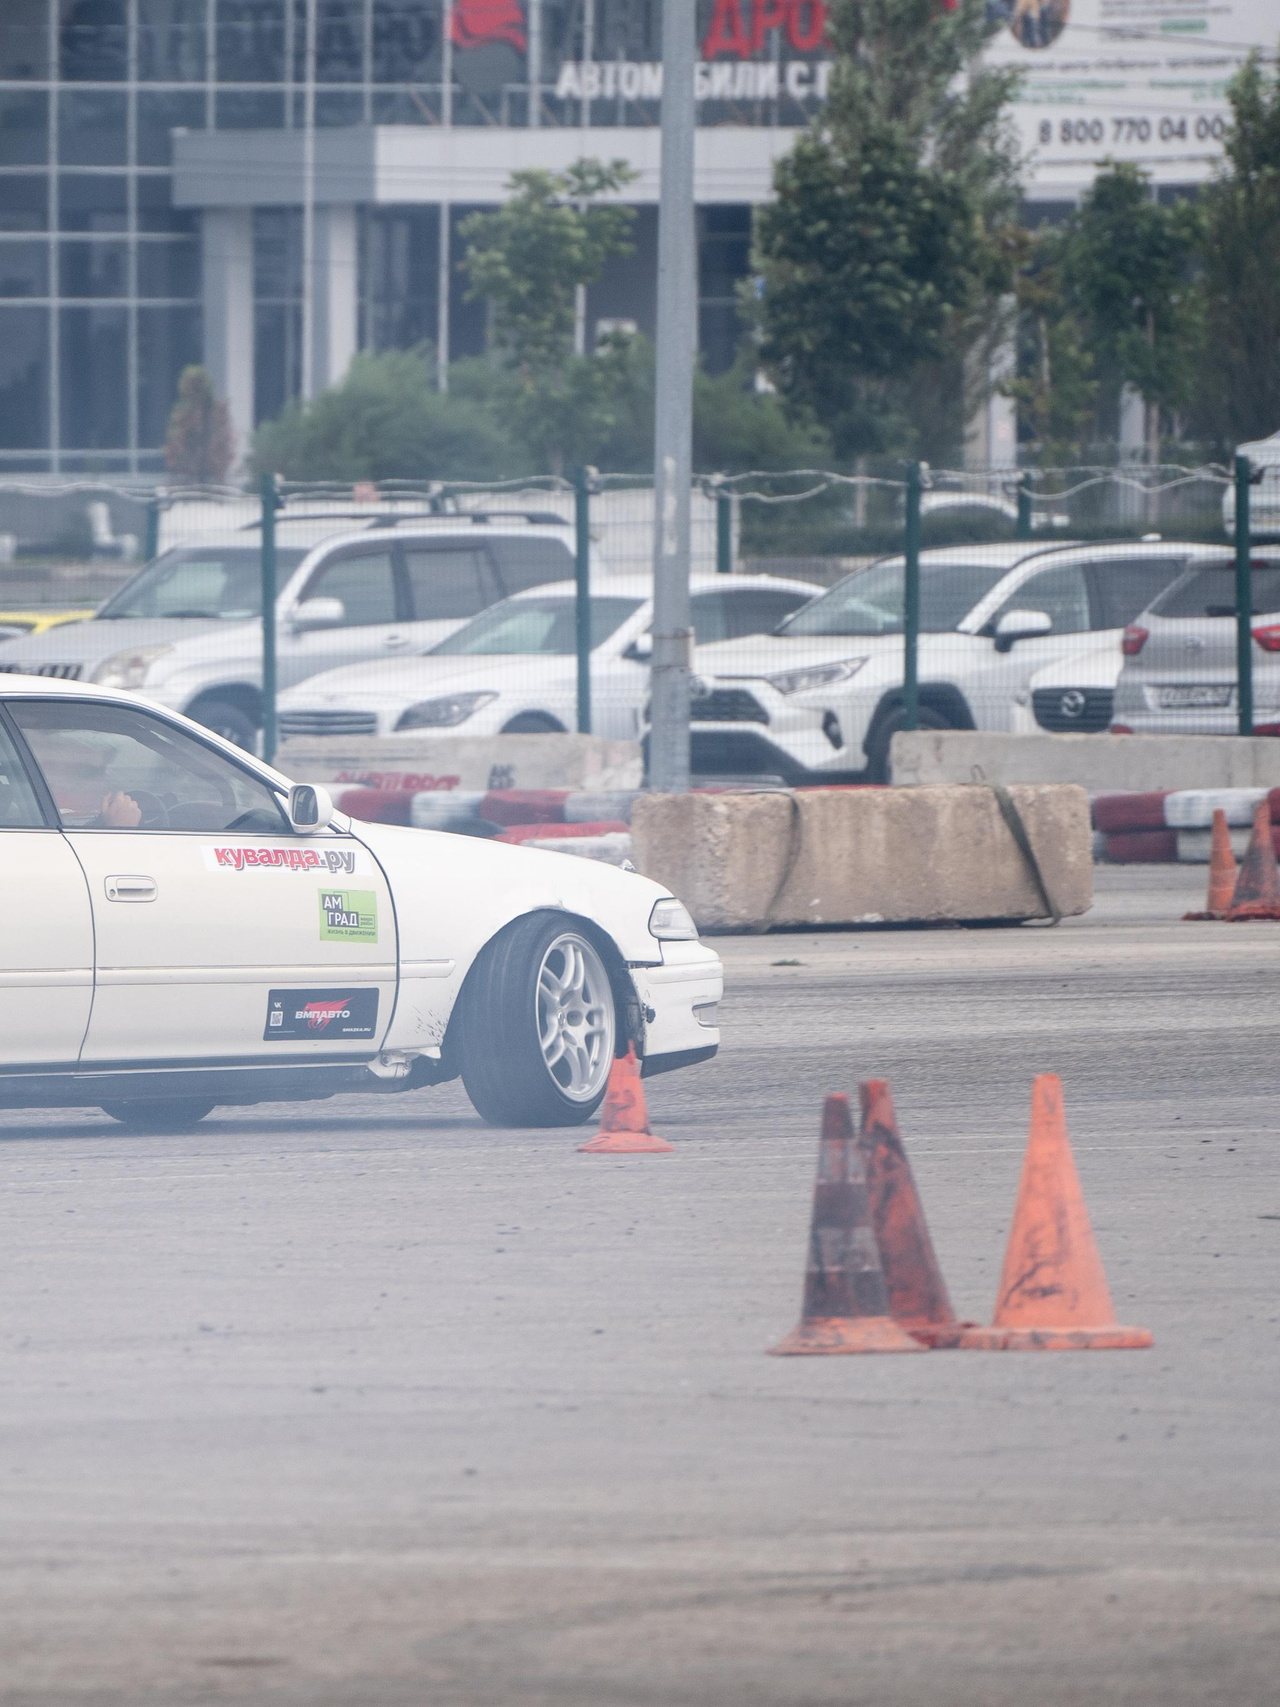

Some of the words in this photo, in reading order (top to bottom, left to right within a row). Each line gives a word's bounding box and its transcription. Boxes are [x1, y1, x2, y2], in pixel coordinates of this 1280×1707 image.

[554, 60, 780, 100] АВТОМБИЛИ
[1060, 117, 1104, 143] 800
[1113, 116, 1151, 142] 770
[1159, 115, 1188, 142] 04
[214, 848, 356, 873] кувалда.ру
[328, 911, 358, 926] ГРАД
[295, 1010, 351, 1020] ВМПАВТО
